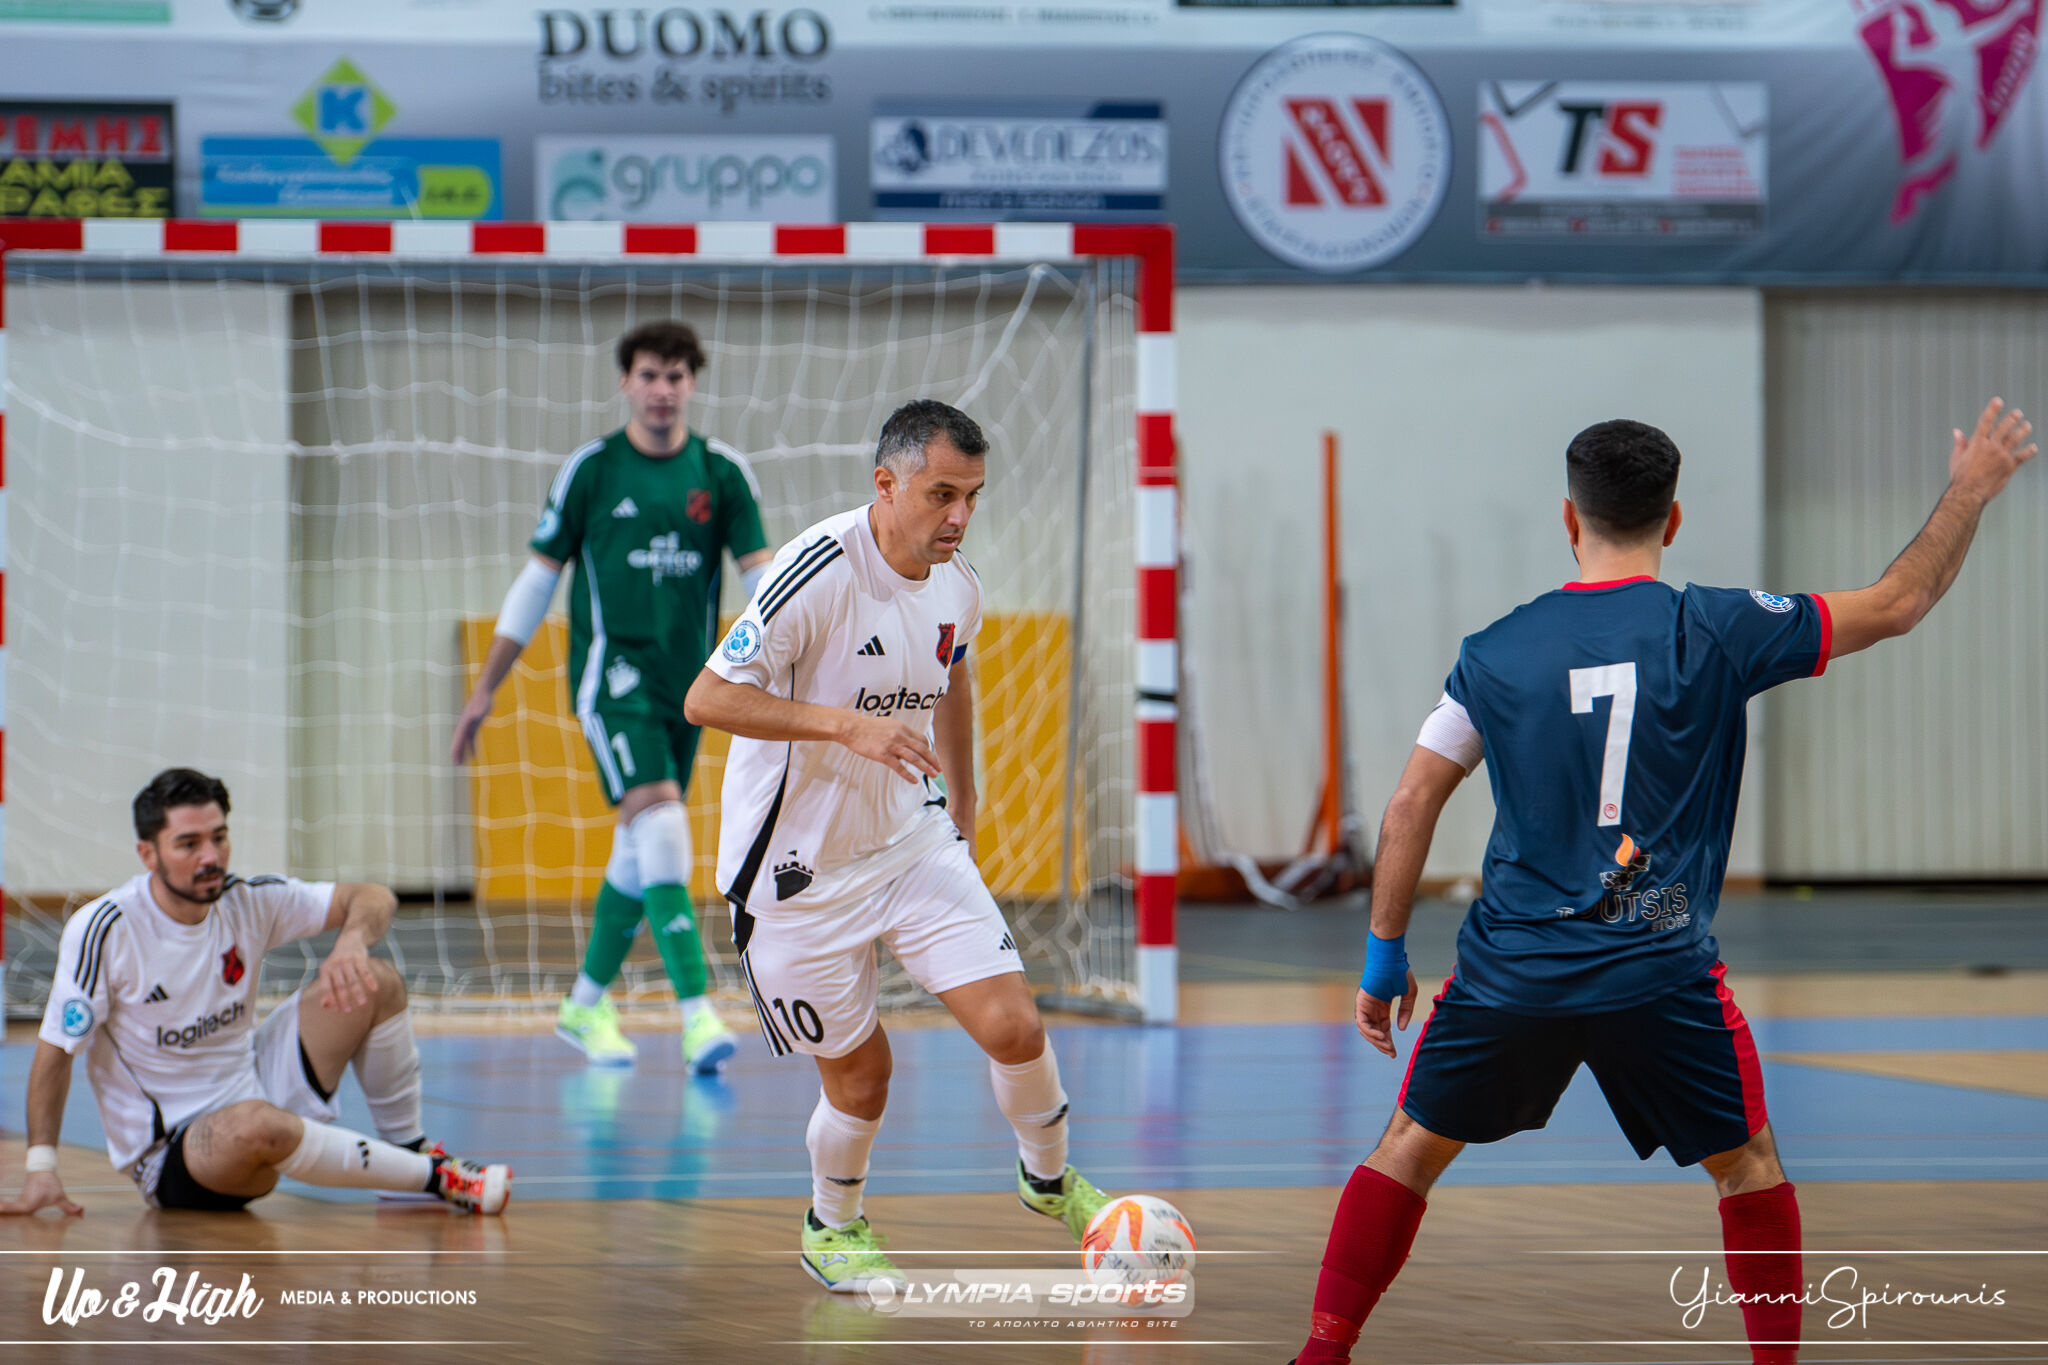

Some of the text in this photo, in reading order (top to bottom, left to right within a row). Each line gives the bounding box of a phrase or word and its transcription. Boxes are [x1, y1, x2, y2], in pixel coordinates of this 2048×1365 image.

[537, 8, 833, 62] DUOMO
[538, 64, 833, 116] bites & spirits
[1560, 101, 1663, 177] TS
[612, 153, 825, 211] gruppo
[855, 686, 945, 717] logtech
[611, 732, 636, 778] 1
[1568, 661, 1638, 827] 7
[1555, 882, 1689, 924] TUTSIS
[773, 997, 824, 1043] 10
